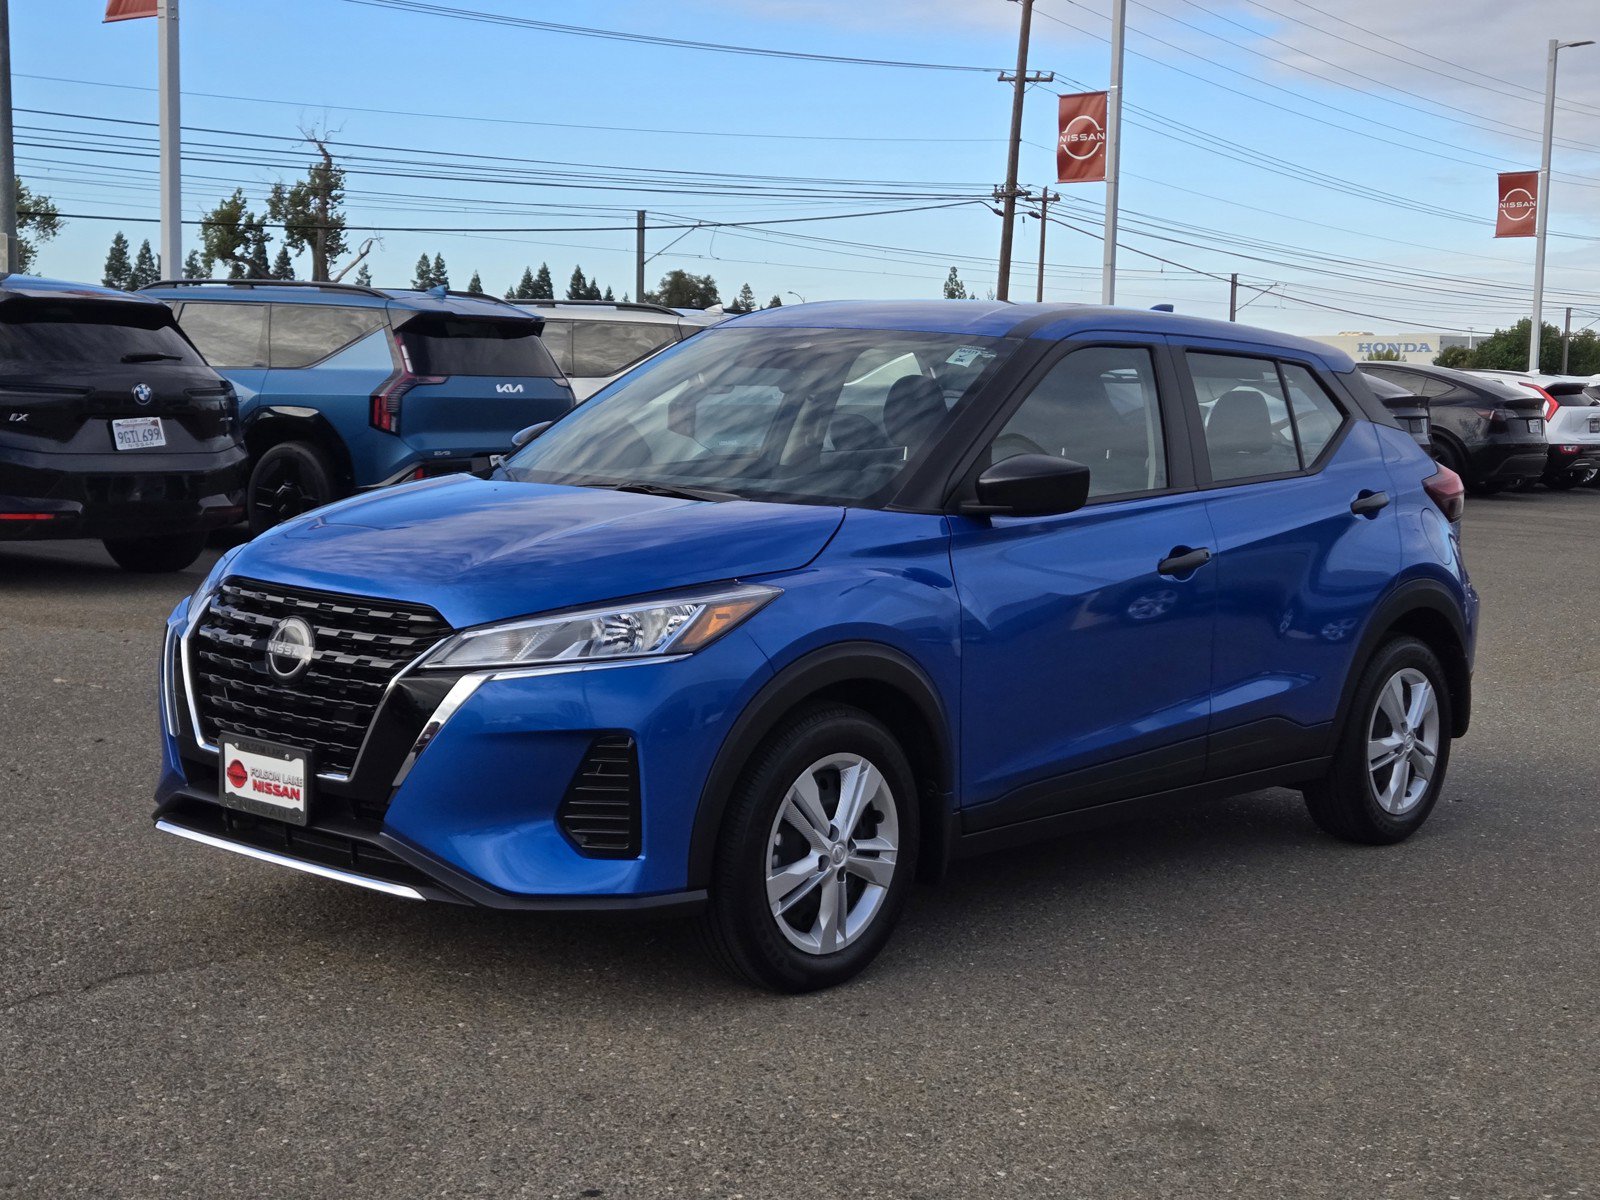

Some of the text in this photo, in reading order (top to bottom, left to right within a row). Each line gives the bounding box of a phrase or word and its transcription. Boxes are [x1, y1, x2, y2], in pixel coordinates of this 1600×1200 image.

[1060, 132, 1105, 143] NISSAN
[1500, 201, 1536, 209] NISSAN
[1357, 342, 1432, 353] HONDA
[495, 383, 524, 393] KIA
[250, 766, 281, 781] FOLSOM
[282, 772, 303, 788] LAKE
[252, 778, 300, 801] NISSAN
